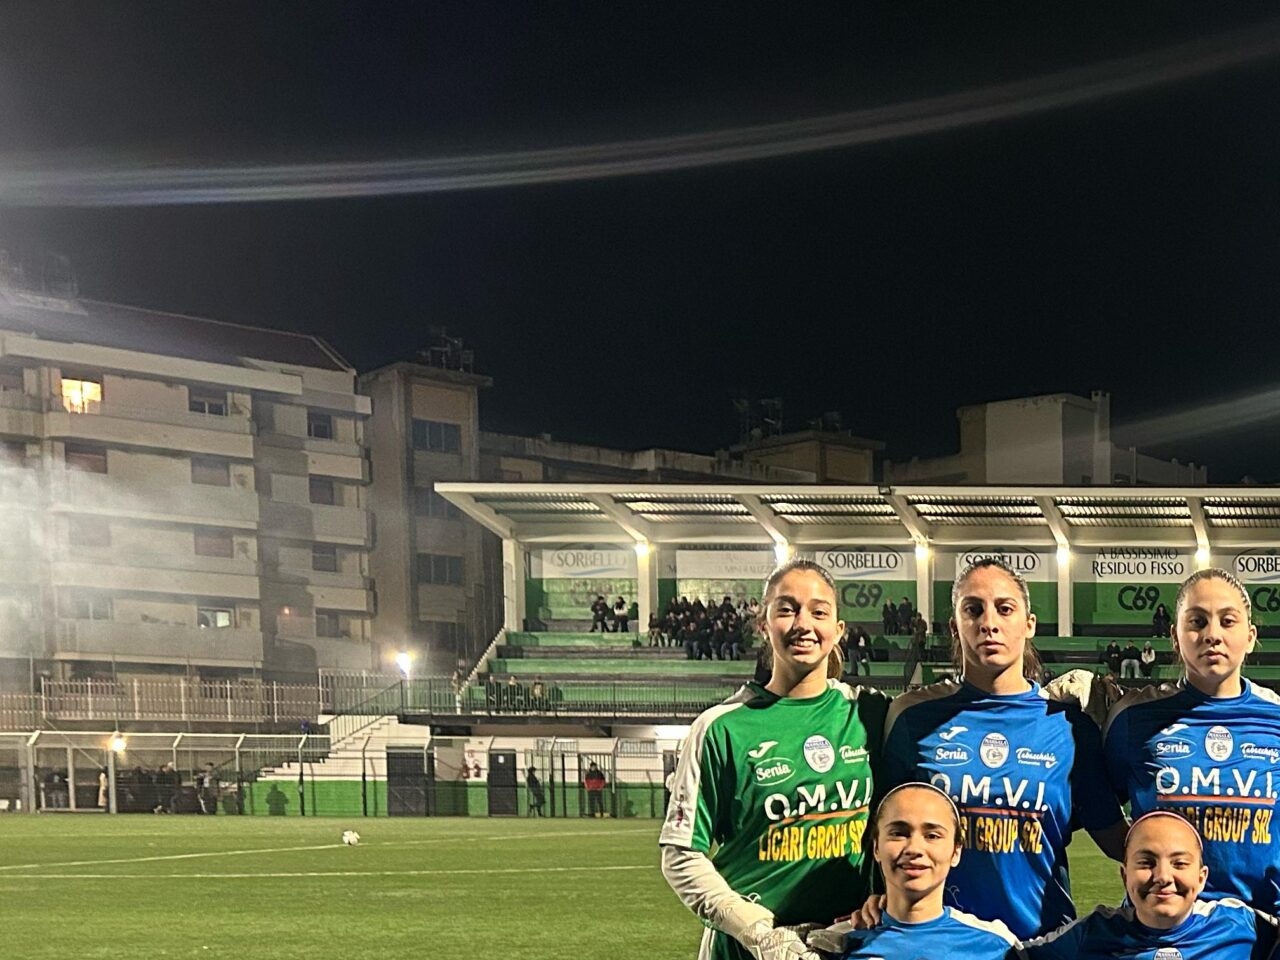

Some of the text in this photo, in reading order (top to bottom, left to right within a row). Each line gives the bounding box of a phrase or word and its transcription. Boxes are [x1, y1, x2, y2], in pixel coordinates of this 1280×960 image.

[827, 552, 898, 570] SORBELLO
[1092, 560, 1184, 577] RESIDUO FISSO
[841, 583, 883, 609] C69
[1117, 585, 1160, 612] C69
[935, 747, 968, 761] Senia
[1156, 741, 1190, 754] Senia
[755, 762, 791, 781] Senia
[1156, 766, 1278, 799] O.M.V.I.
[975, 815, 1019, 854] GROUP
[1020, 821, 1043, 854] SRL
[1203, 805, 1251, 844] GROUP
[1251, 808, 1274, 844] SRL
[807, 822, 848, 860] GROUP
